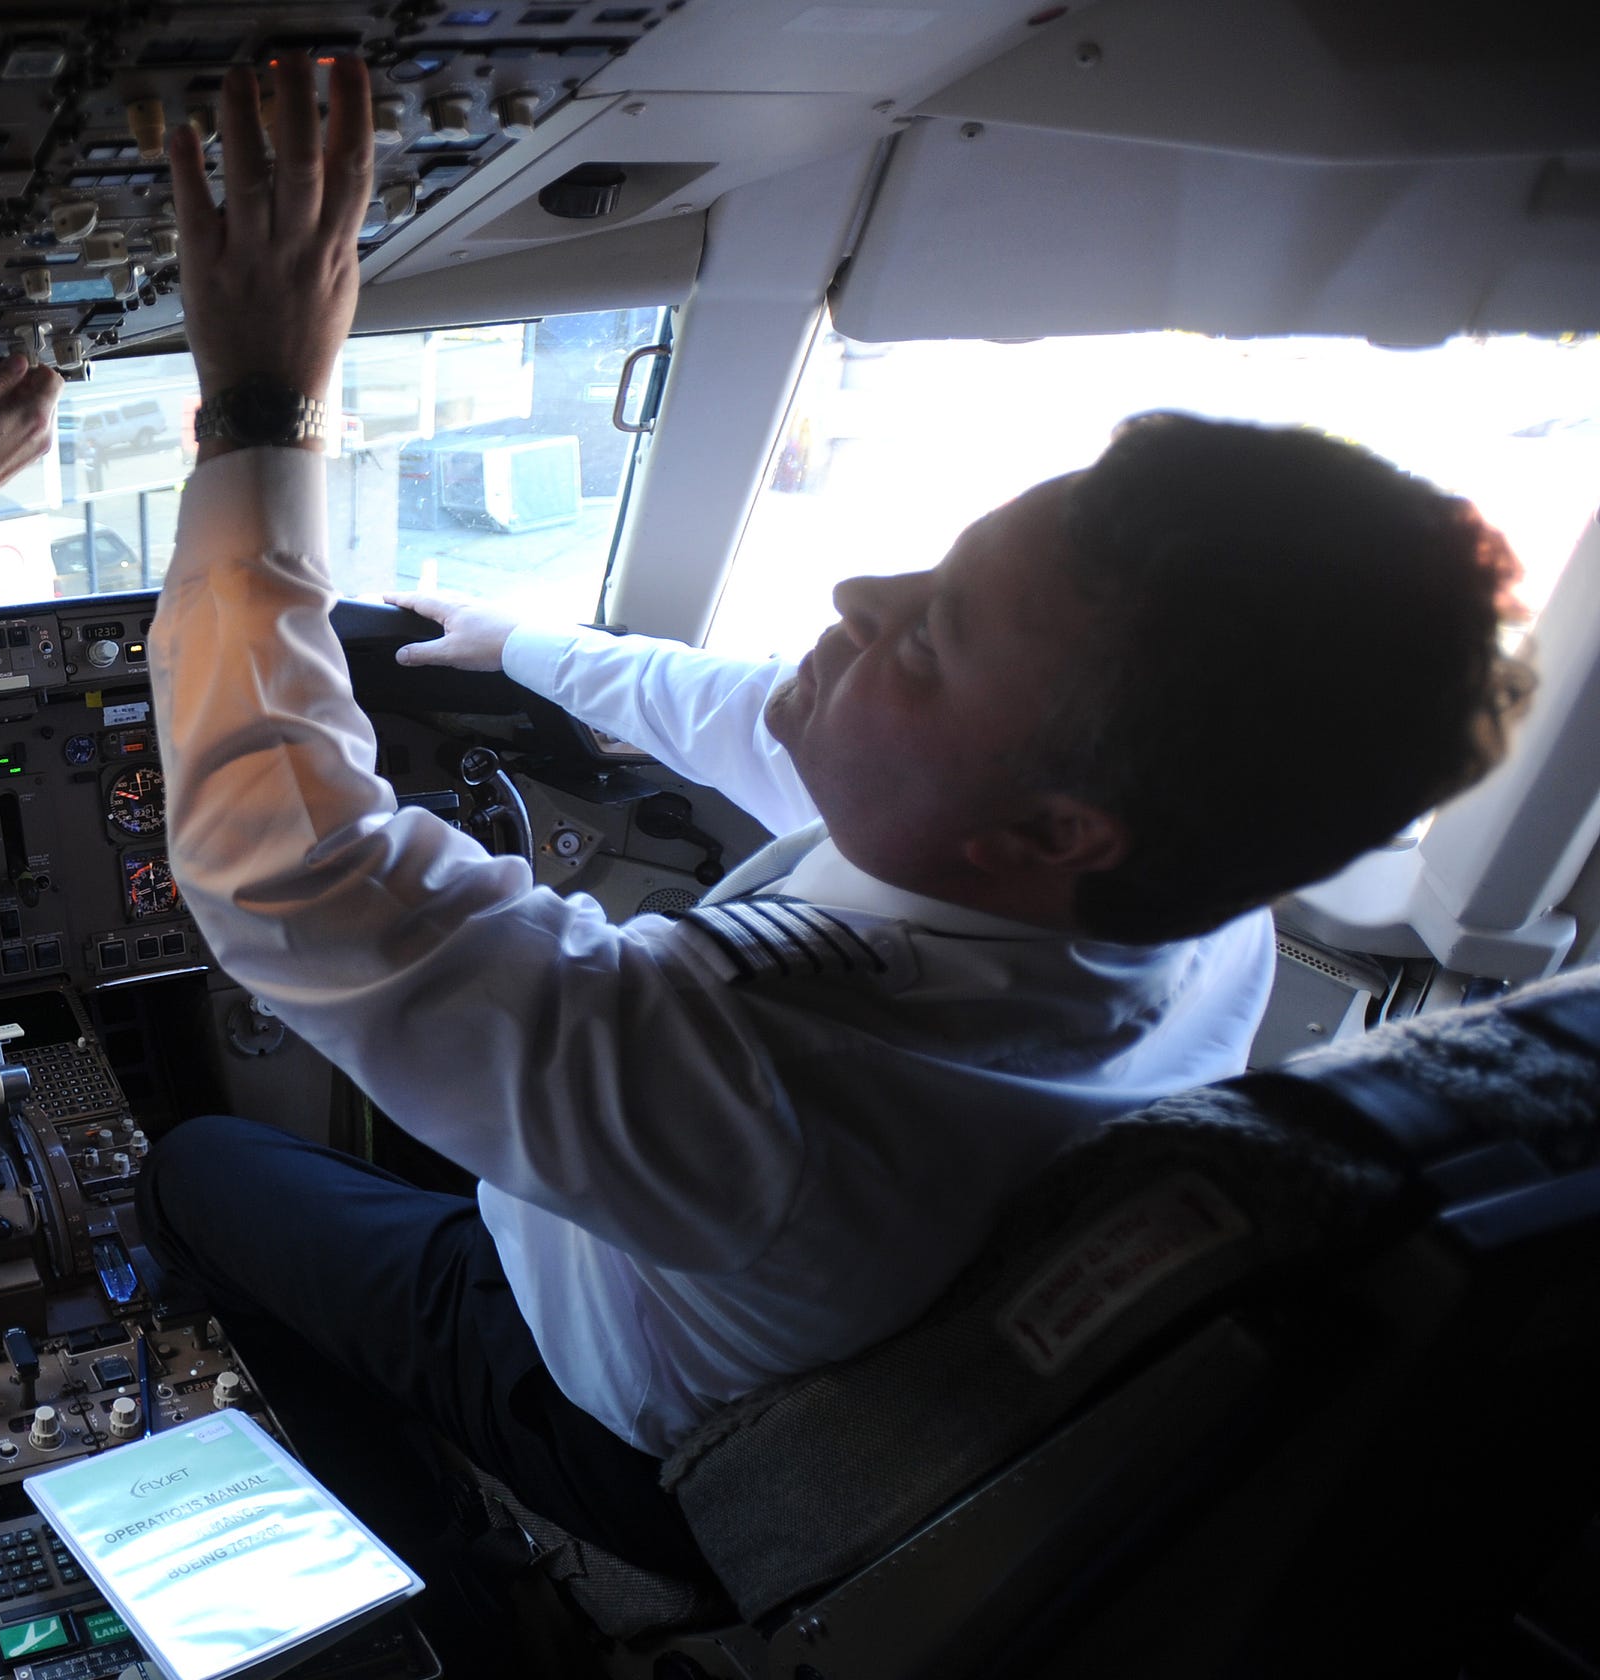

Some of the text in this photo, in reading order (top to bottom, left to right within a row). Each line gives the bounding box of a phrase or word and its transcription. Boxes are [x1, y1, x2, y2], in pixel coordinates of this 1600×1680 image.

[139, 1467, 190, 1494] FLYJET
[104, 1474, 269, 1544] OPERATIONS MANUAL
[167, 1547, 229, 1580] BOEING
